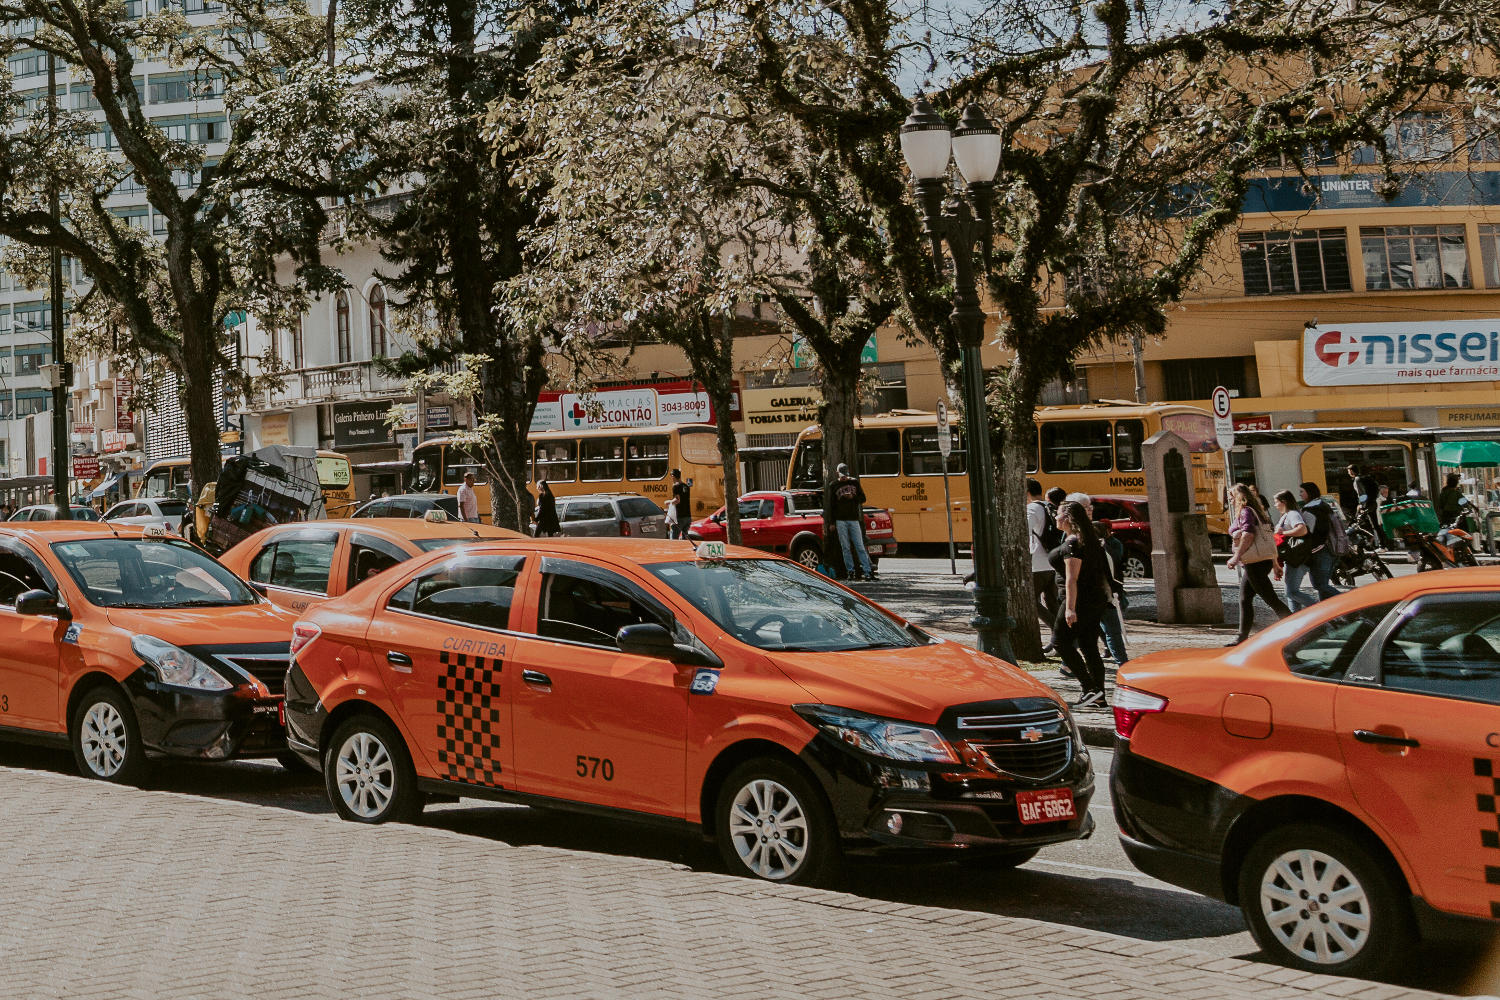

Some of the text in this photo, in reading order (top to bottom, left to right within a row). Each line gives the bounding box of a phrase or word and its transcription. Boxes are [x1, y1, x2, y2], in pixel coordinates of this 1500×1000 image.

[1322, 181, 1370, 192] UNINTER
[1361, 332, 1498, 365] nissei
[1397, 365, 1498, 378] mais que farmácia
[600, 397, 651, 408] RMÁCIAS
[661, 400, 706, 413] 3043-8009
[771, 396, 813, 407] GALERIA
[1219, 395, 1225, 412] E
[335, 413, 353, 423] Galeria
[376, 410, 389, 420] Lim
[749, 415, 783, 424] TOBIAS
[1110, 477, 1144, 487] MN608
[430, 511, 445, 520] TAXI
[706, 544, 724, 555] TAXI
[292, 601, 310, 610] CURI
[64, 632, 77, 640] 156
[443, 637, 506, 657] CURITIBA
[692, 680, 713, 692] 156
[576, 755, 614, 781] 570
[1020, 799, 1074, 820] BAF-6862
